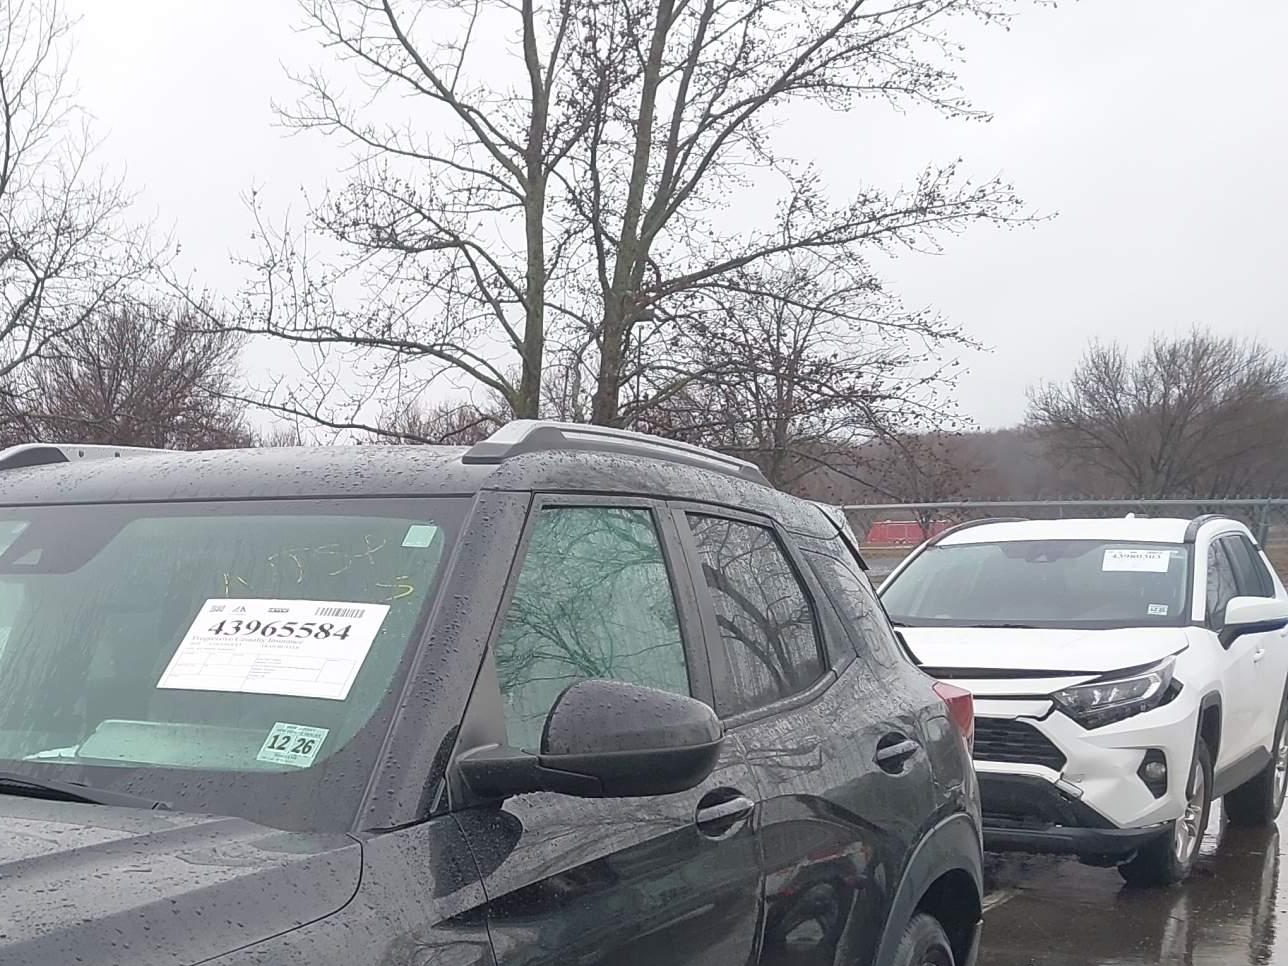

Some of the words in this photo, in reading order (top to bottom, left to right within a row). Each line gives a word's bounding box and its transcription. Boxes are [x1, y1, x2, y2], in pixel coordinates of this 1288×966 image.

[208, 619, 352, 641] 43965584
[268, 735, 290, 750] 12
[292, 738, 315, 754] 26
